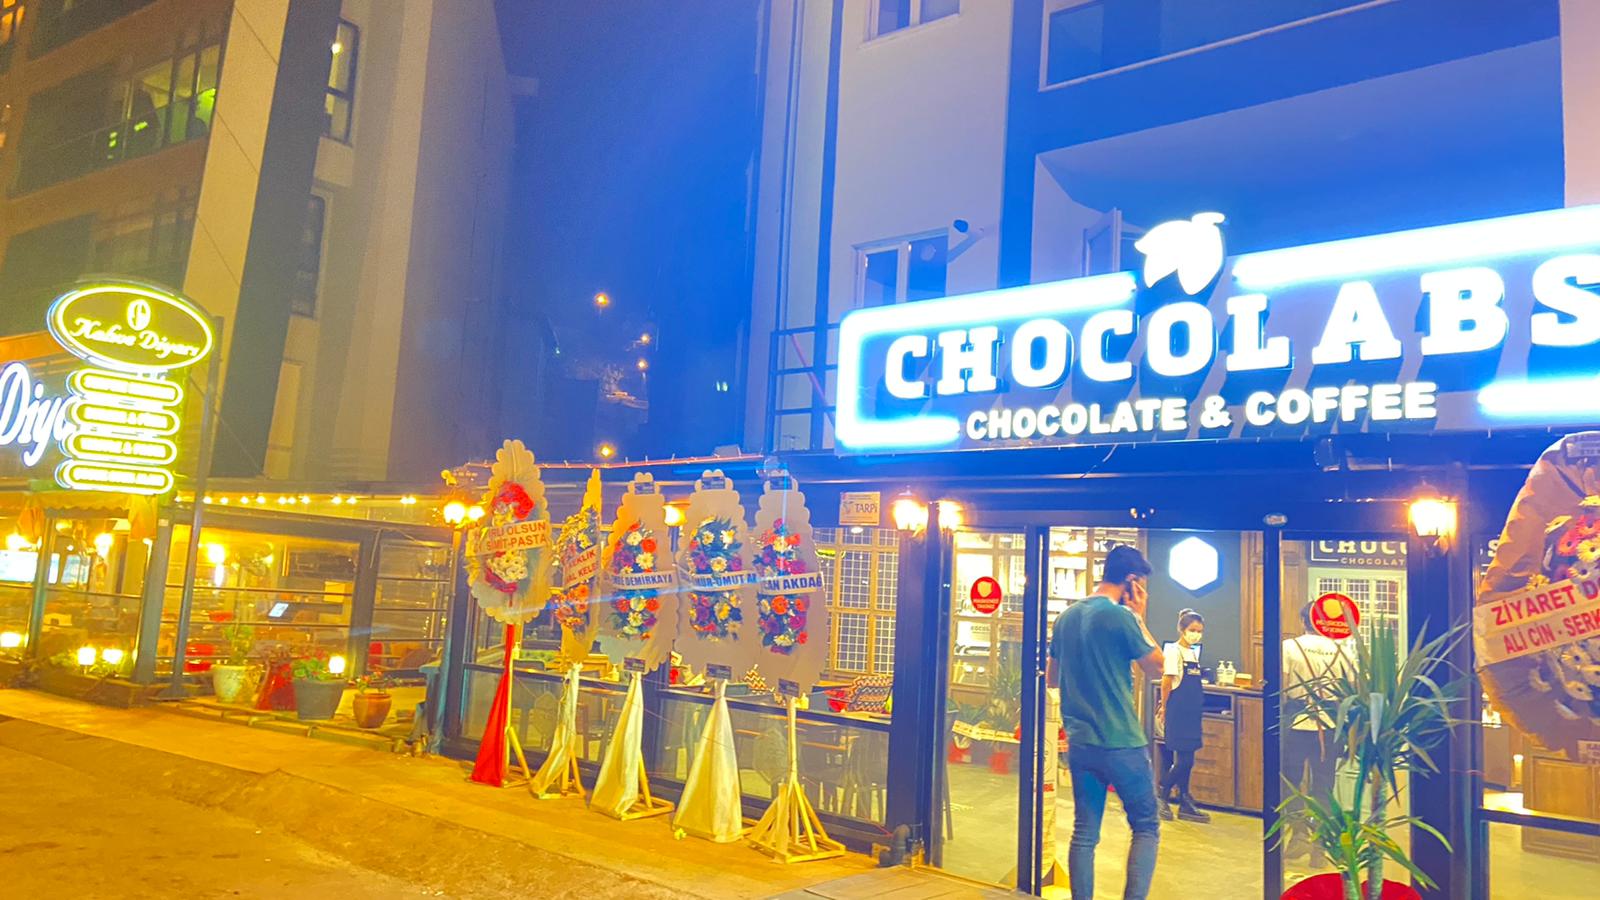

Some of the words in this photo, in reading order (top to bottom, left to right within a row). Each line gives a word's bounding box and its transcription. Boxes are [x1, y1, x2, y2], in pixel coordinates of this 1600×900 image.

[885, 254, 1600, 400] CHOCOLABS
[966, 398, 1187, 440] CHOCOLATE
[1200, 395, 1232, 428] &
[1245, 381, 1437, 426] COFFEE
[507, 522, 546, 535] OLSUN
[1491, 585, 1577, 626] ZİYARET
[1582, 576, 1600, 600] D
[1503, 631, 1528, 654] ALİ
